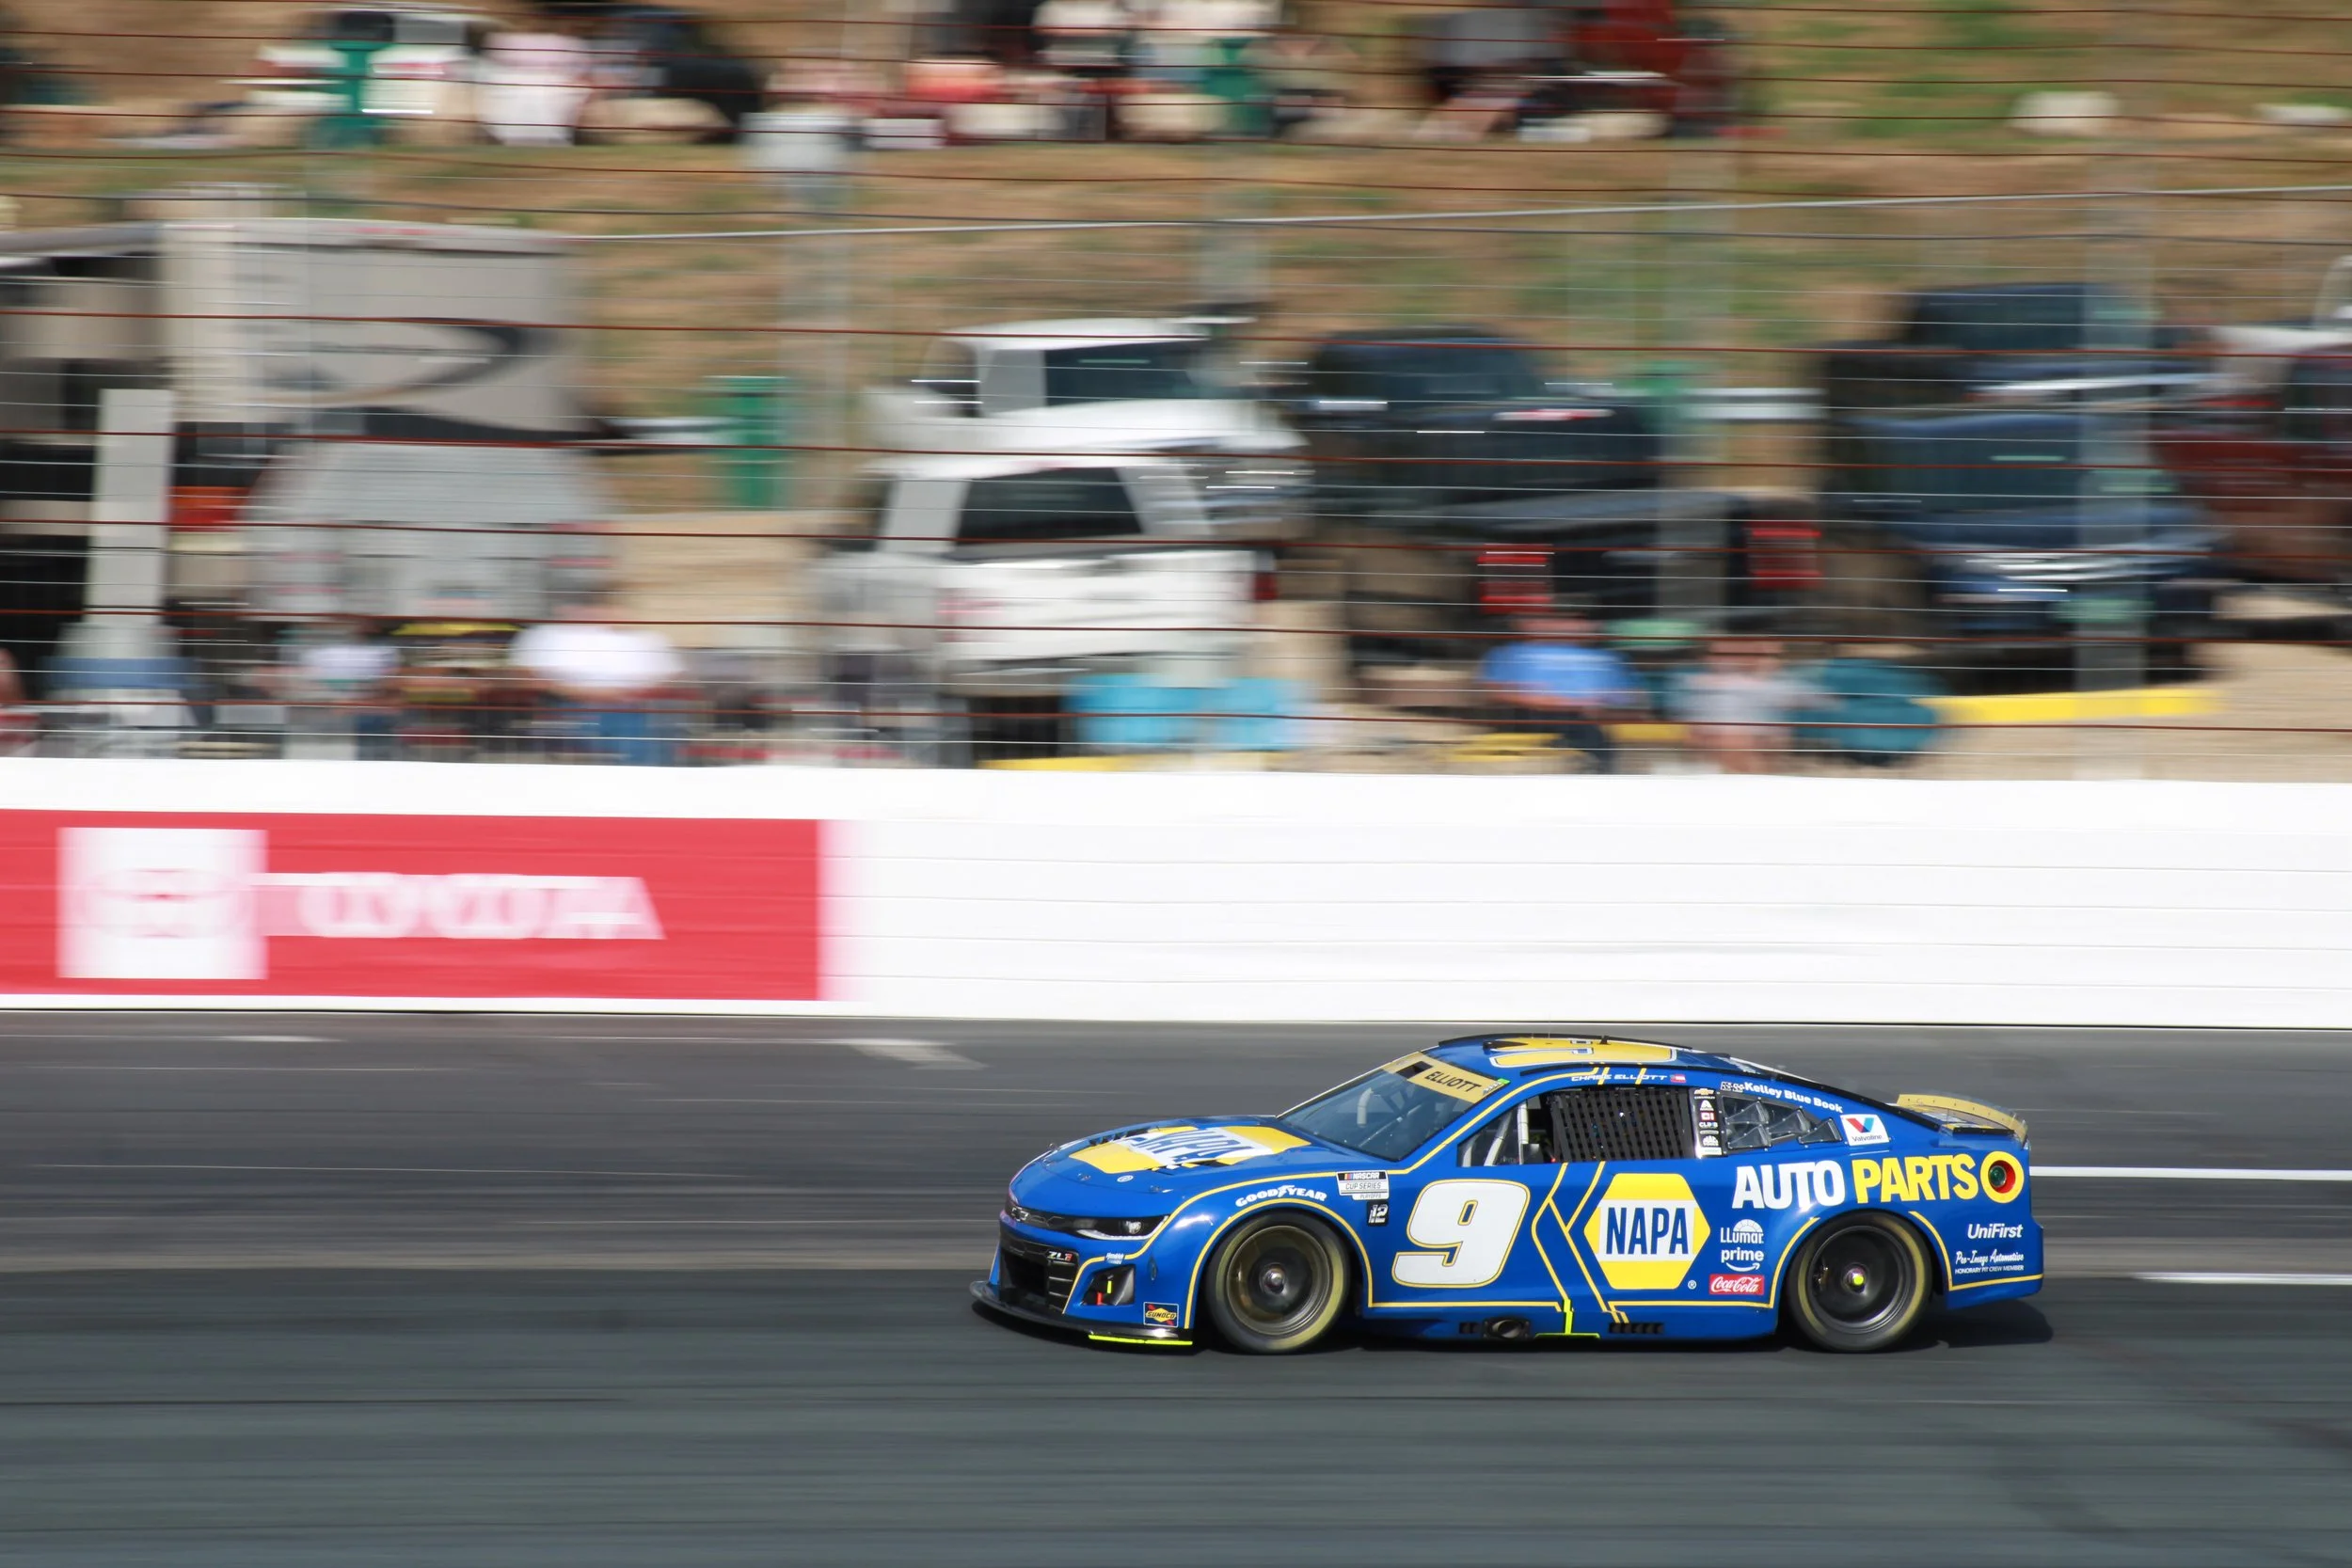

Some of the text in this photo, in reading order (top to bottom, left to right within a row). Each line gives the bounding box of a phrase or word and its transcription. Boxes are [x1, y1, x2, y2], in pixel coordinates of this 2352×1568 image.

[1424, 1071, 1482, 1092] ELLIOTT
[1744, 1082, 1782, 1099] Kelley
[1784, 1089, 1811, 1104] Blue
[1813, 1097, 1843, 1114] Book
[1732, 1153, 1979, 1211] AUTO PARTS
[1234, 1184, 1327, 1208] GOODYEAR
[1391, 1179, 1531, 1289] 9
[1606, 1207, 1689, 1255] NAPA
[1720, 1227, 1764, 1244] LLumar
[1967, 1223, 2024, 1240] UniFirst
[1721, 1246, 1765, 1263] prime
[1147, 1310, 1176, 1320] SUNOCO
